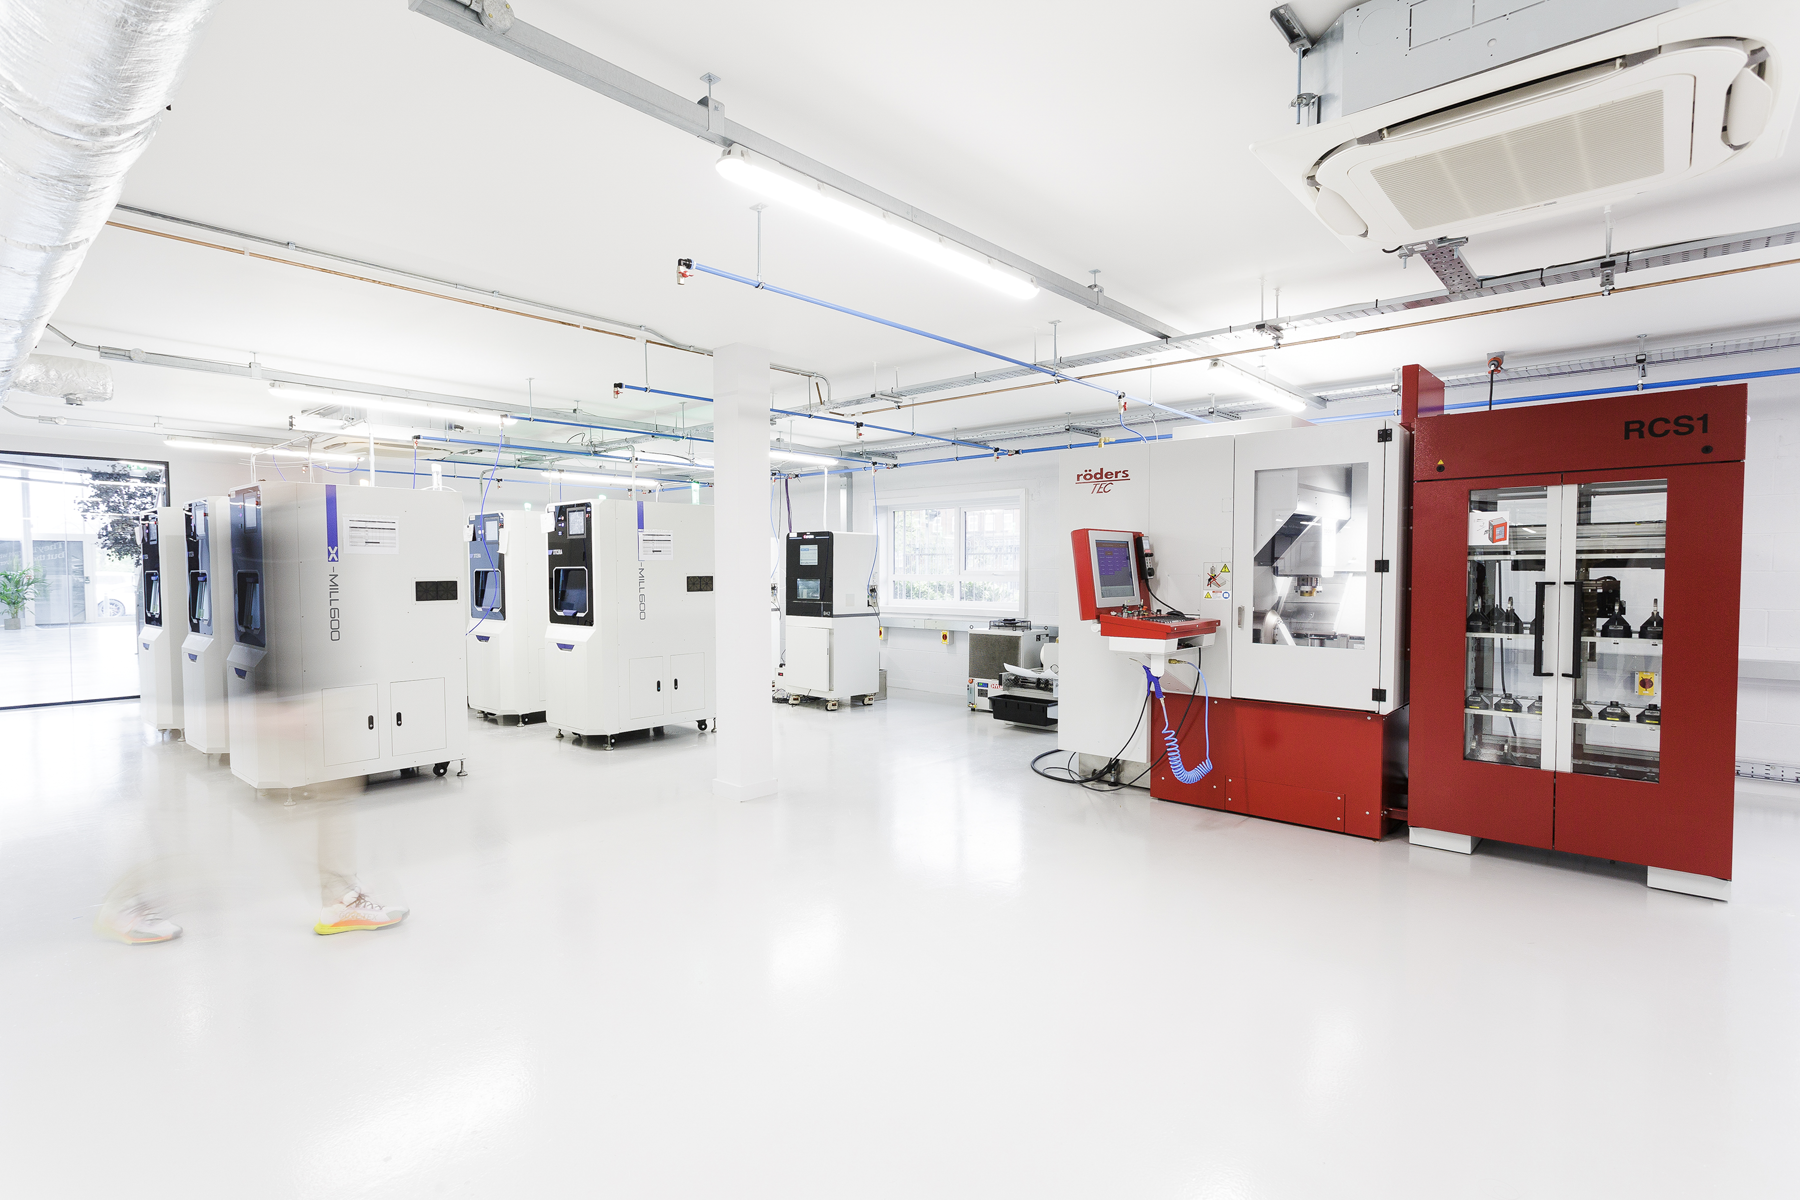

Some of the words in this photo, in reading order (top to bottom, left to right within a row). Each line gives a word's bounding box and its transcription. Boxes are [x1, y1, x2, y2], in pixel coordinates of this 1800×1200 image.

[1624, 413, 1709, 440] RCS1
[1076, 467, 1130, 482] röders
[1091, 482, 1114, 494] TEC
